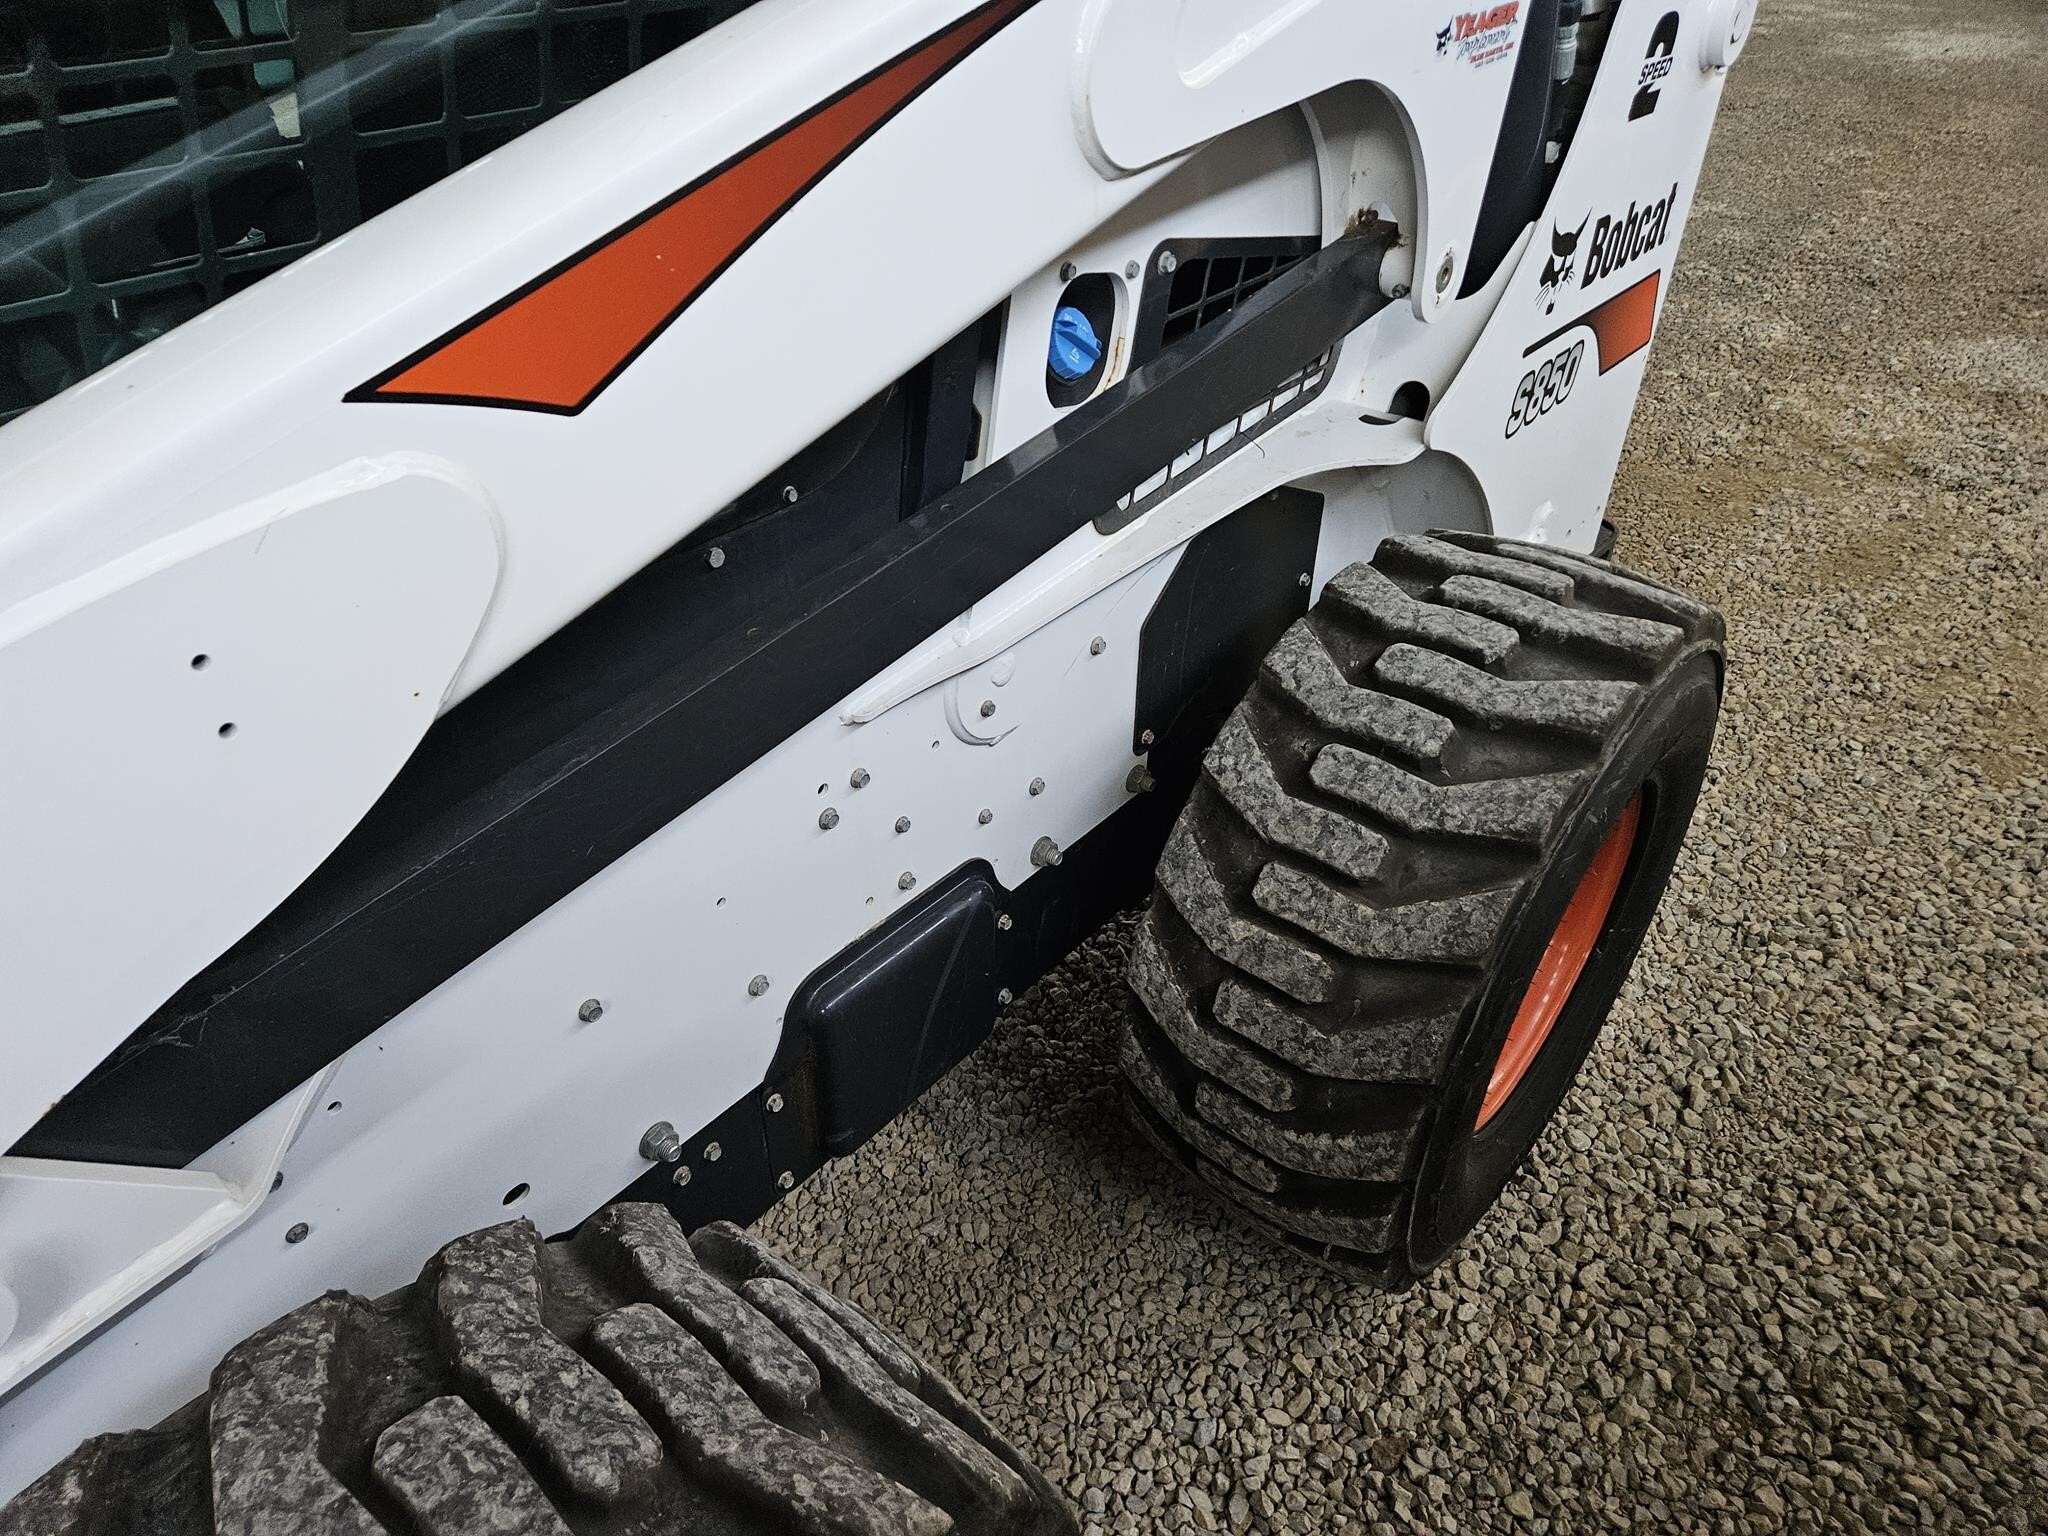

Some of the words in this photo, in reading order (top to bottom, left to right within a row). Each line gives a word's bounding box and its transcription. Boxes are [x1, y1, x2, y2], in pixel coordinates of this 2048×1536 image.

[1453, 1, 1519, 42] YEAGER
[1628, 10, 1680, 122] 2
[1637, 56, 1674, 86] SPEED
[1579, 181, 1679, 290] Bobcat
[1504, 339, 1585, 440] S850
